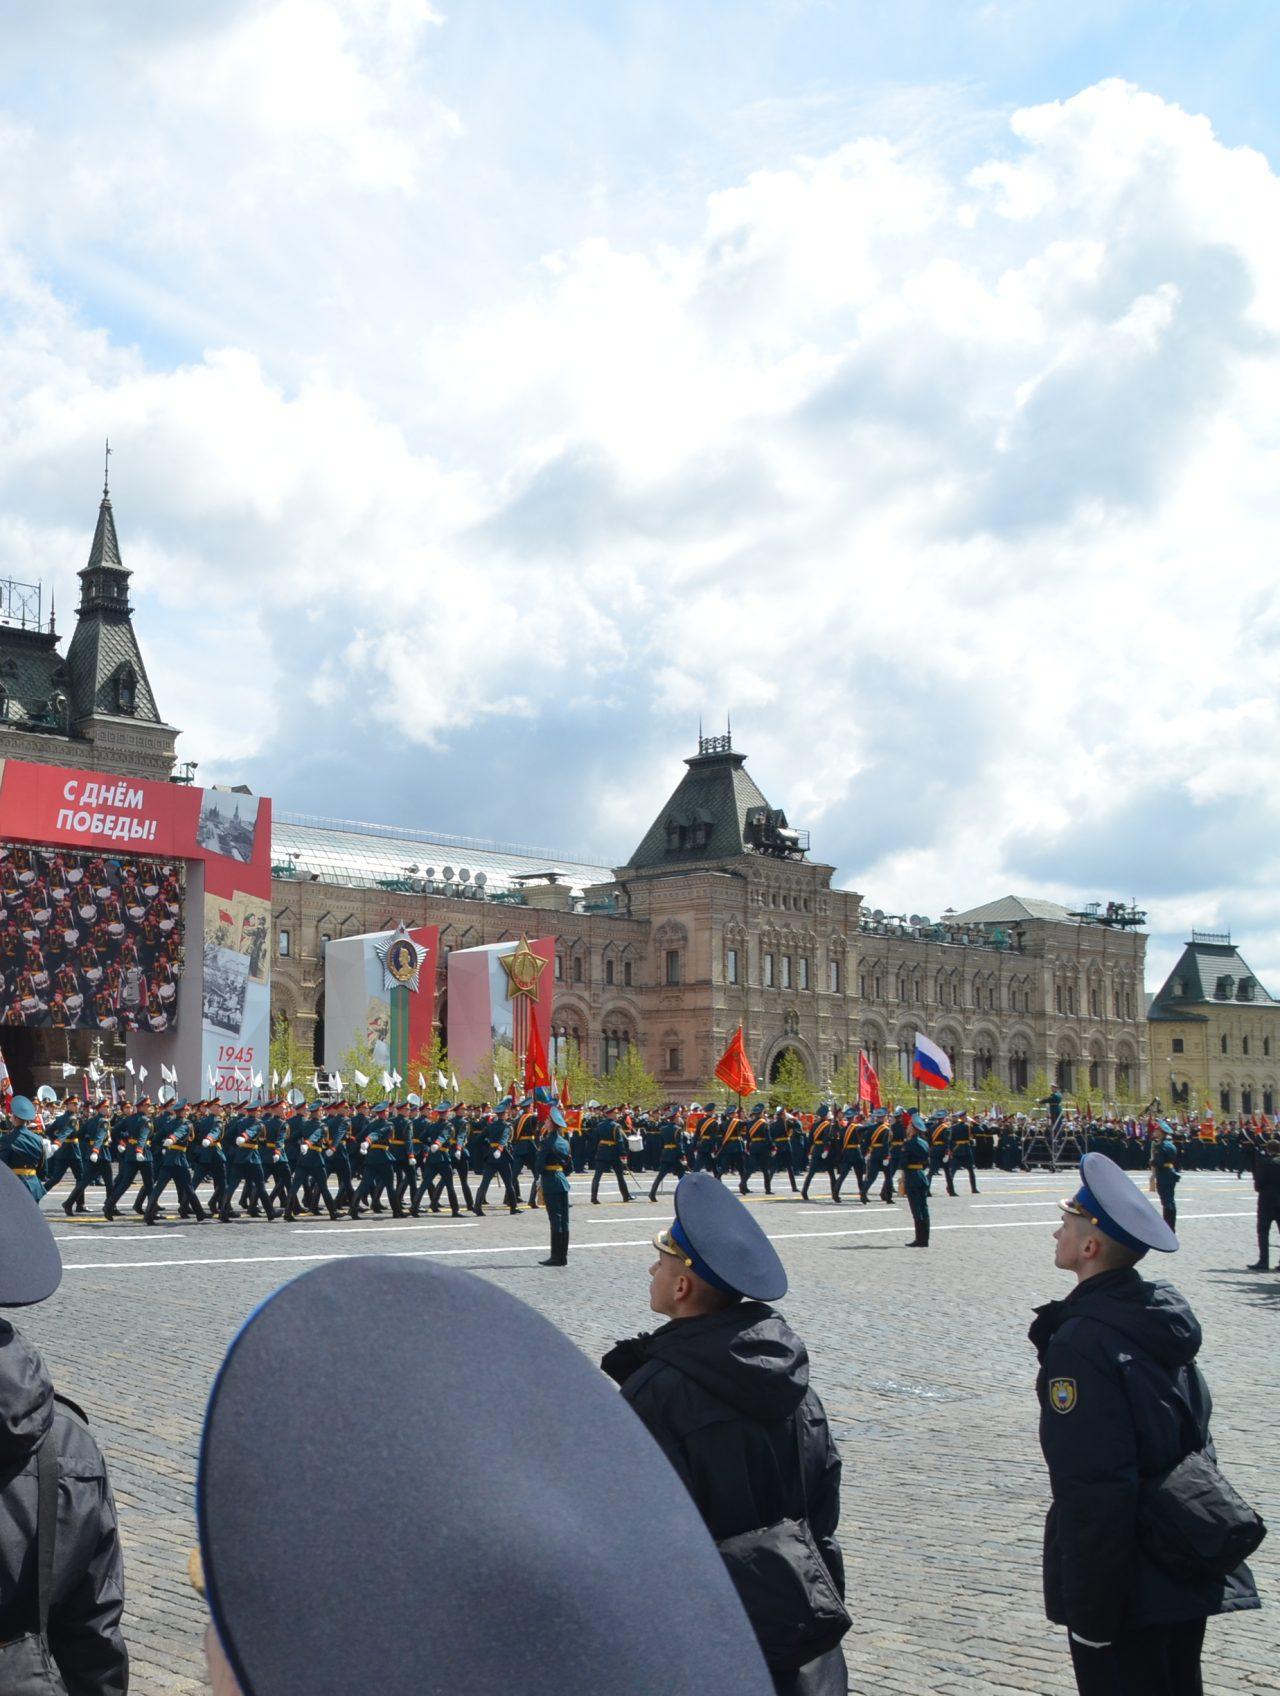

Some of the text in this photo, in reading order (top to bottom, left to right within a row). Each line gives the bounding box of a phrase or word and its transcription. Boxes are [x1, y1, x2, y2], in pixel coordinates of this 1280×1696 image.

[63, 780, 144, 810] С ДНЁМ
[56, 808, 157, 841] ПОБЕДЫ!
[218, 1045, 254, 1063] 1945
